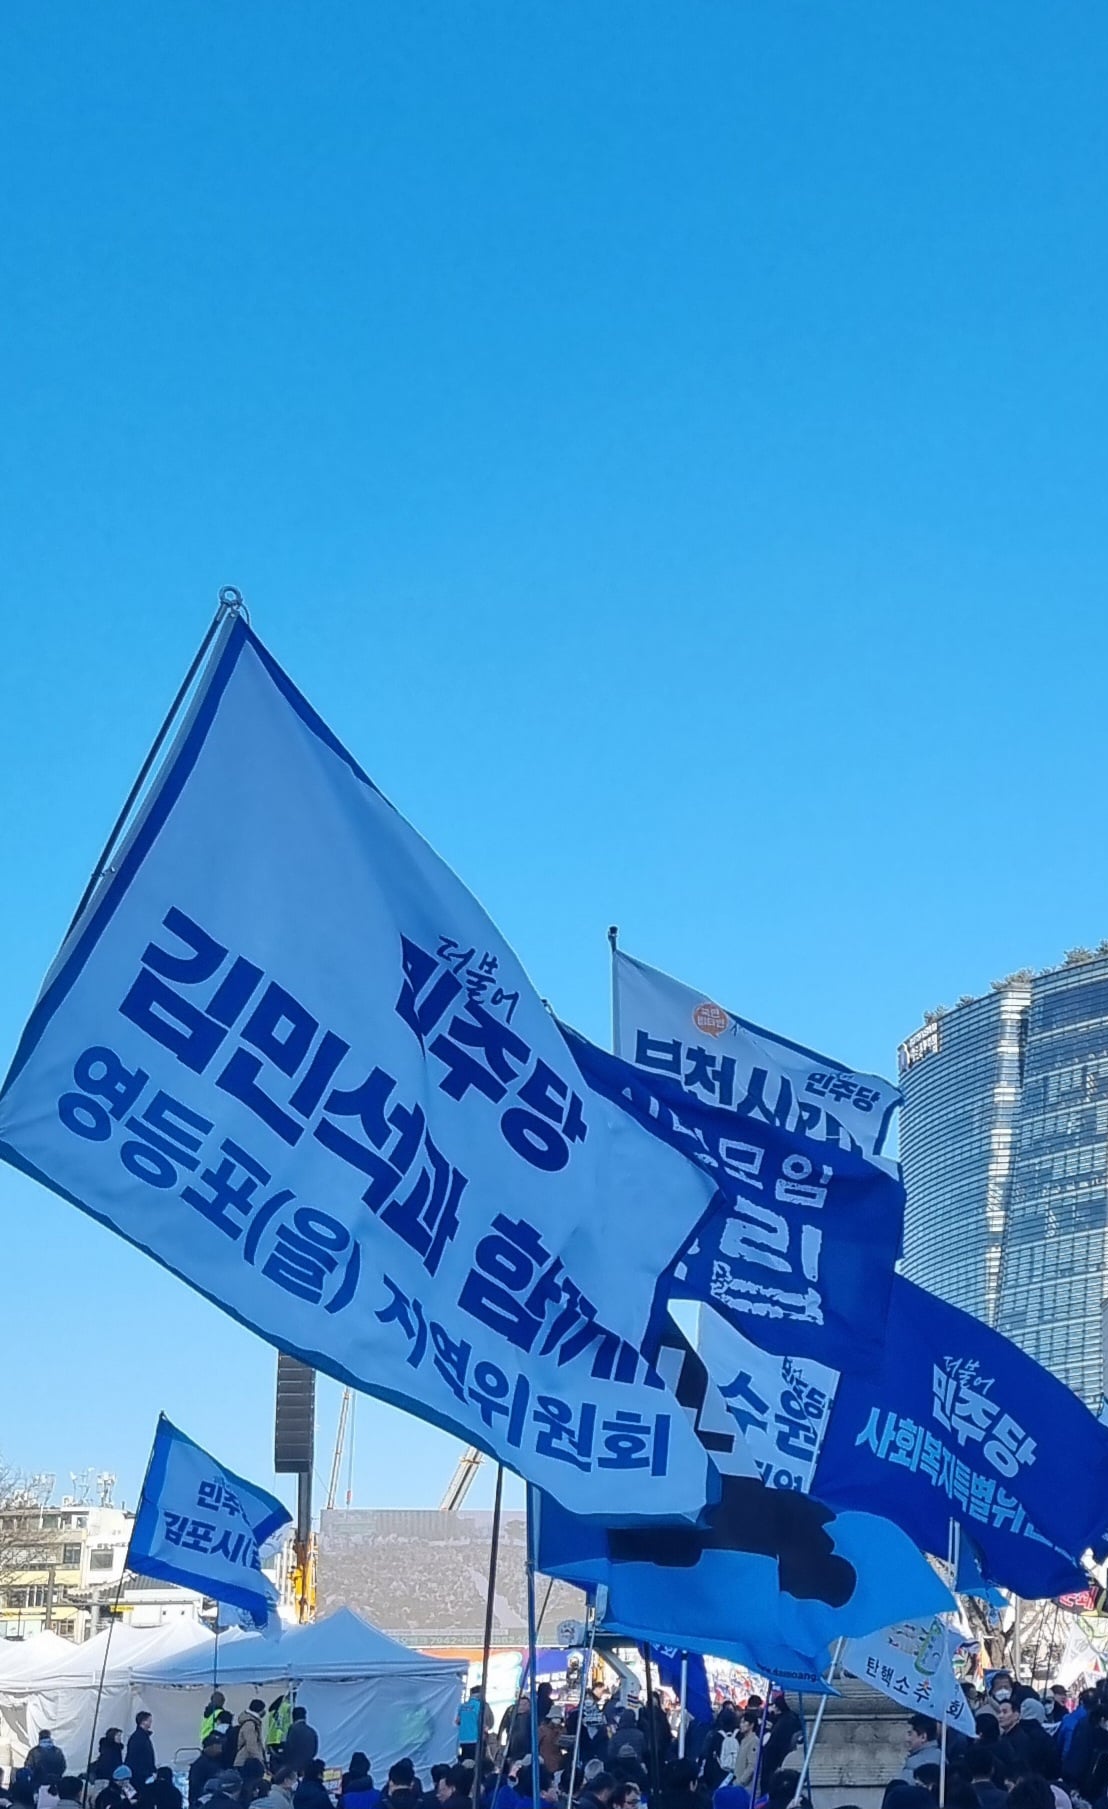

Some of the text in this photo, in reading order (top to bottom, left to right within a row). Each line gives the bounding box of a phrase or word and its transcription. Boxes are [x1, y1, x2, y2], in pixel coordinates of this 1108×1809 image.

[435, 935, 519, 1025] 더불어
[118, 905, 470, 1278] 김민석과
[395, 932, 588, 1172] 민주당
[804, 1072, 881, 1113] 민주당
[57, 1045, 361, 1315] 영등포(을)
[374, 1272, 672, 1477] 지역위원회
[932, 1363, 1038, 1478] 민주당
[943, 1355, 996, 1395] 더불어
[197, 1480, 246, 1518] 민주
[855, 1406, 1056, 1548] 사회복지특별위
